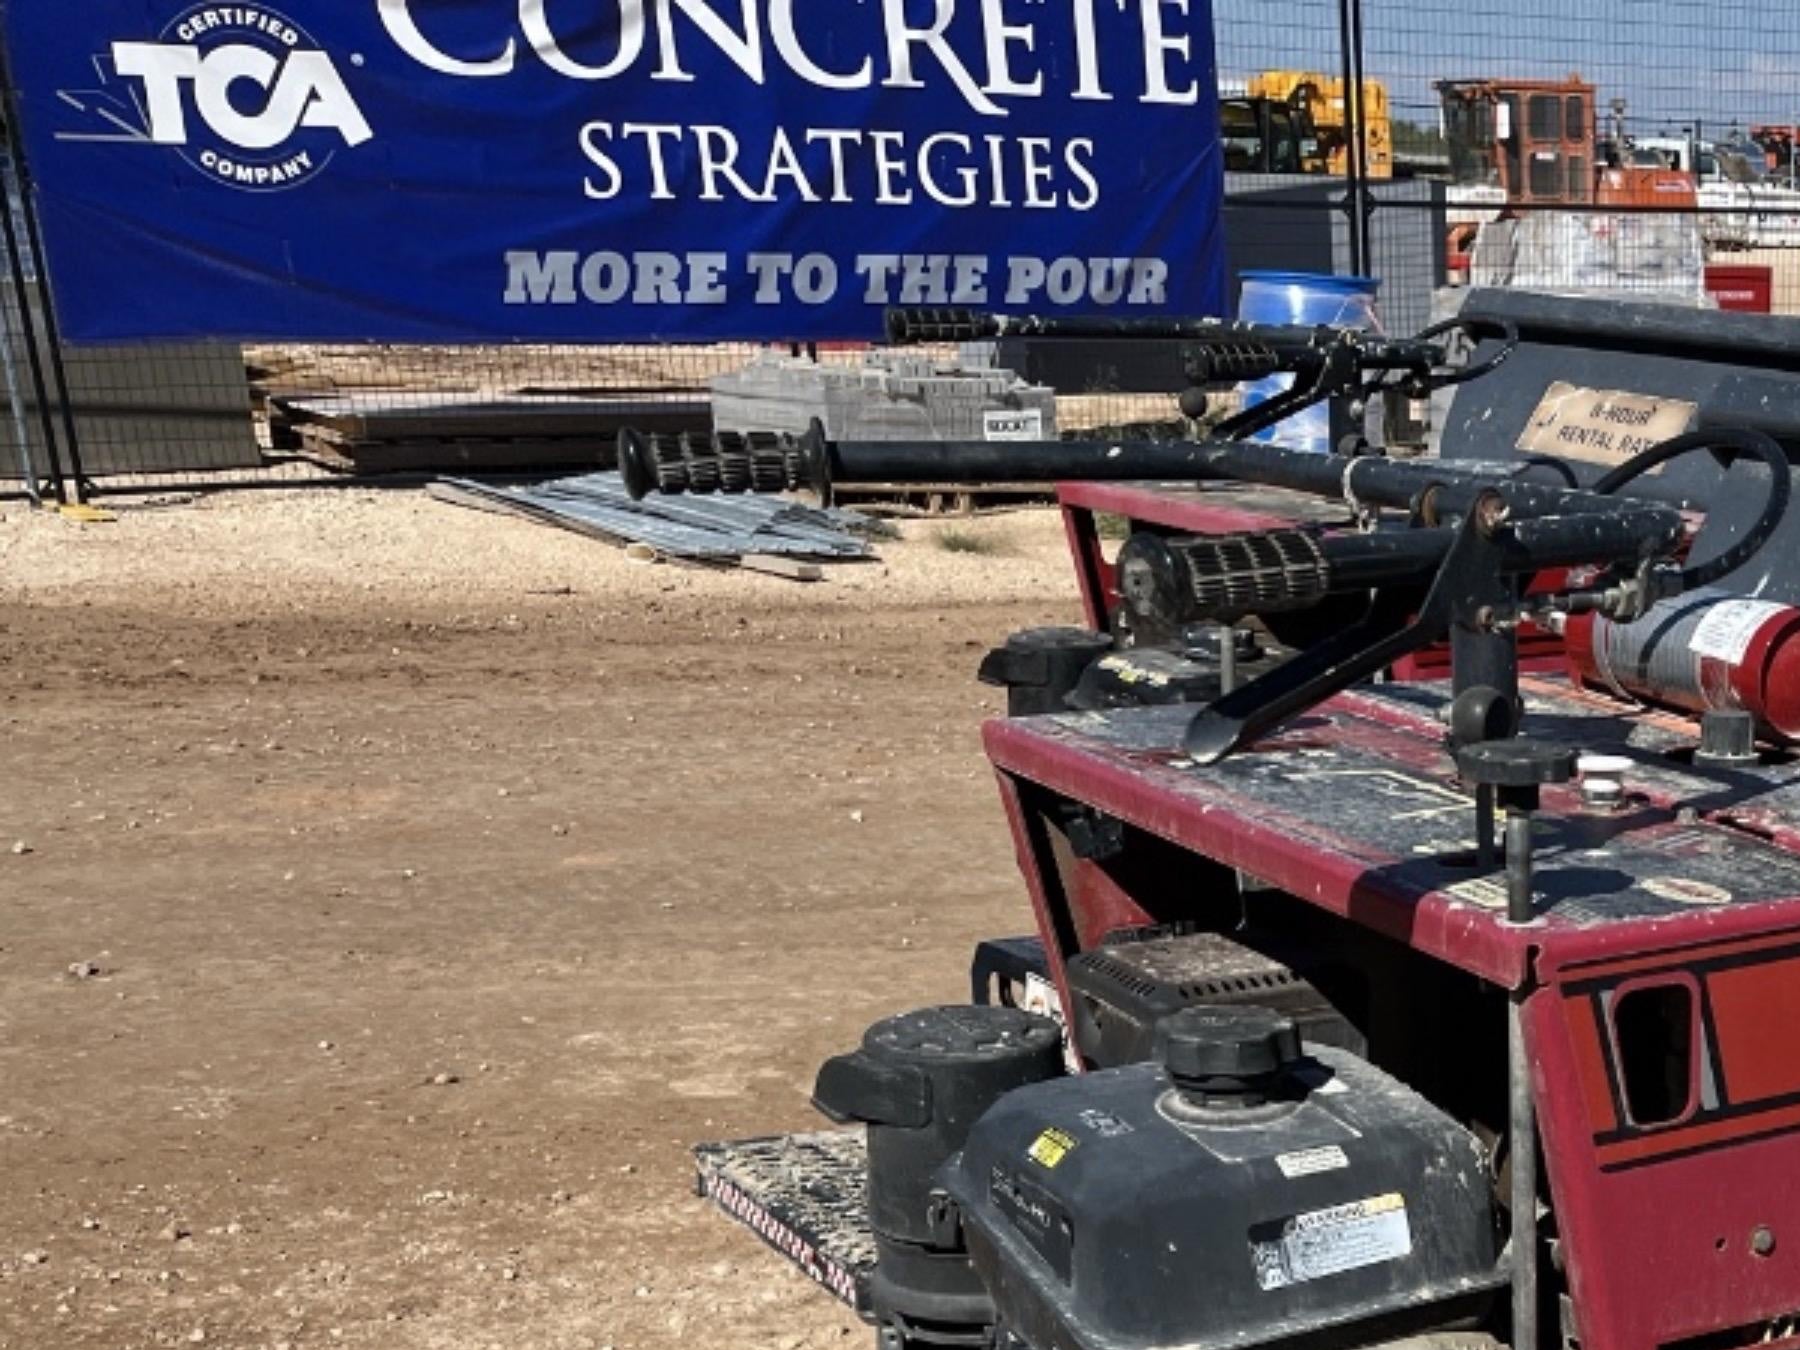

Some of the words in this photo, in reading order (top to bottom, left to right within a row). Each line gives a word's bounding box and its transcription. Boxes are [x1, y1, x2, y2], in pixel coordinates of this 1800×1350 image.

[176, 7, 299, 46] CERTIFIED
[376, 0, 1199, 116] CONCRETE
[111, 41, 374, 148] TCA
[200, 150, 314, 184] COMPANY
[577, 120, 1100, 211] STRATEGIES
[503, 250, 728, 304] MORE
[746, 251, 839, 304] TO
[855, 253, 989, 304] THE
[1004, 256, 1169, 304] POUR
[1556, 425, 1614, 451] RENTAL
